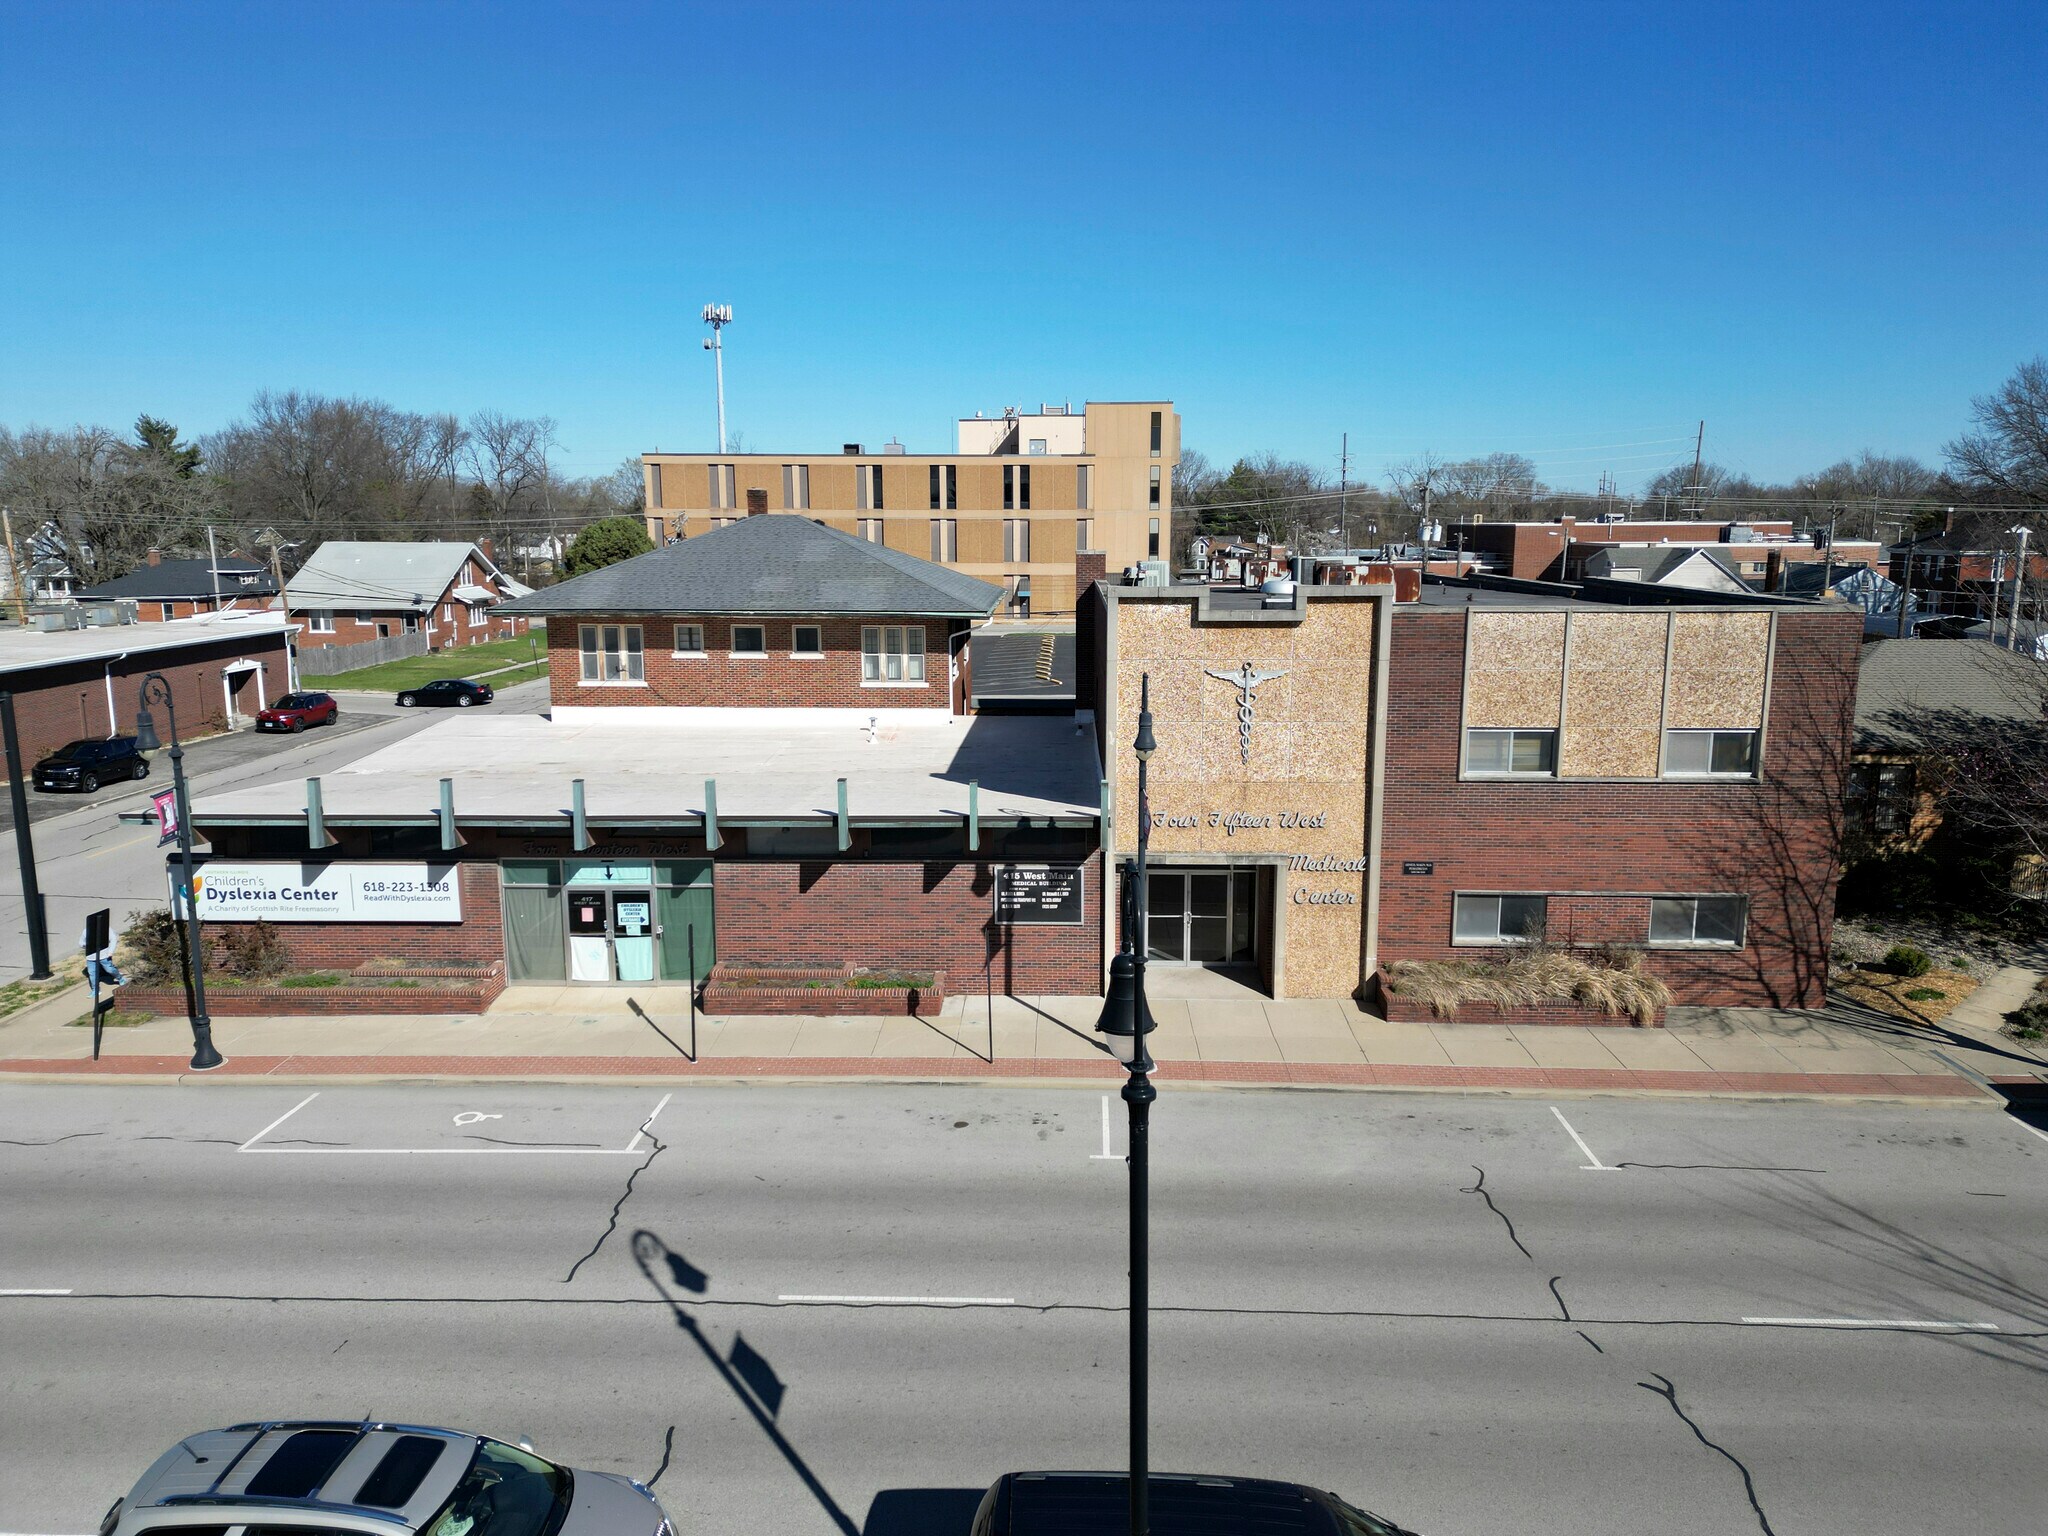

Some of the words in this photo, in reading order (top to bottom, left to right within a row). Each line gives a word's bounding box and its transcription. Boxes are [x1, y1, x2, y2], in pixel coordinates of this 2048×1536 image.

[1152, 809, 1199, 828] Four
[1207, 810, 1271, 836] Fifteen
[1277, 809, 1327, 828] West
[522, 840, 558, 856] Four
[647, 840, 689, 856] West
[1287, 854, 1369, 872] Medical
[204, 875, 264, 886] Children's
[1003, 872, 1021, 880] 415
[1022, 872, 1046, 880] West
[1048, 872, 1075, 880] Main
[363, 881, 450, 893] 618-223-1308
[206, 887, 277, 903] Dyslexia
[280, 887, 339, 901] Center
[363, 894, 451, 904] ReadWithDyslexia.com
[1293, 887, 1357, 905] Center
[213, 905, 240, 913] Charity
